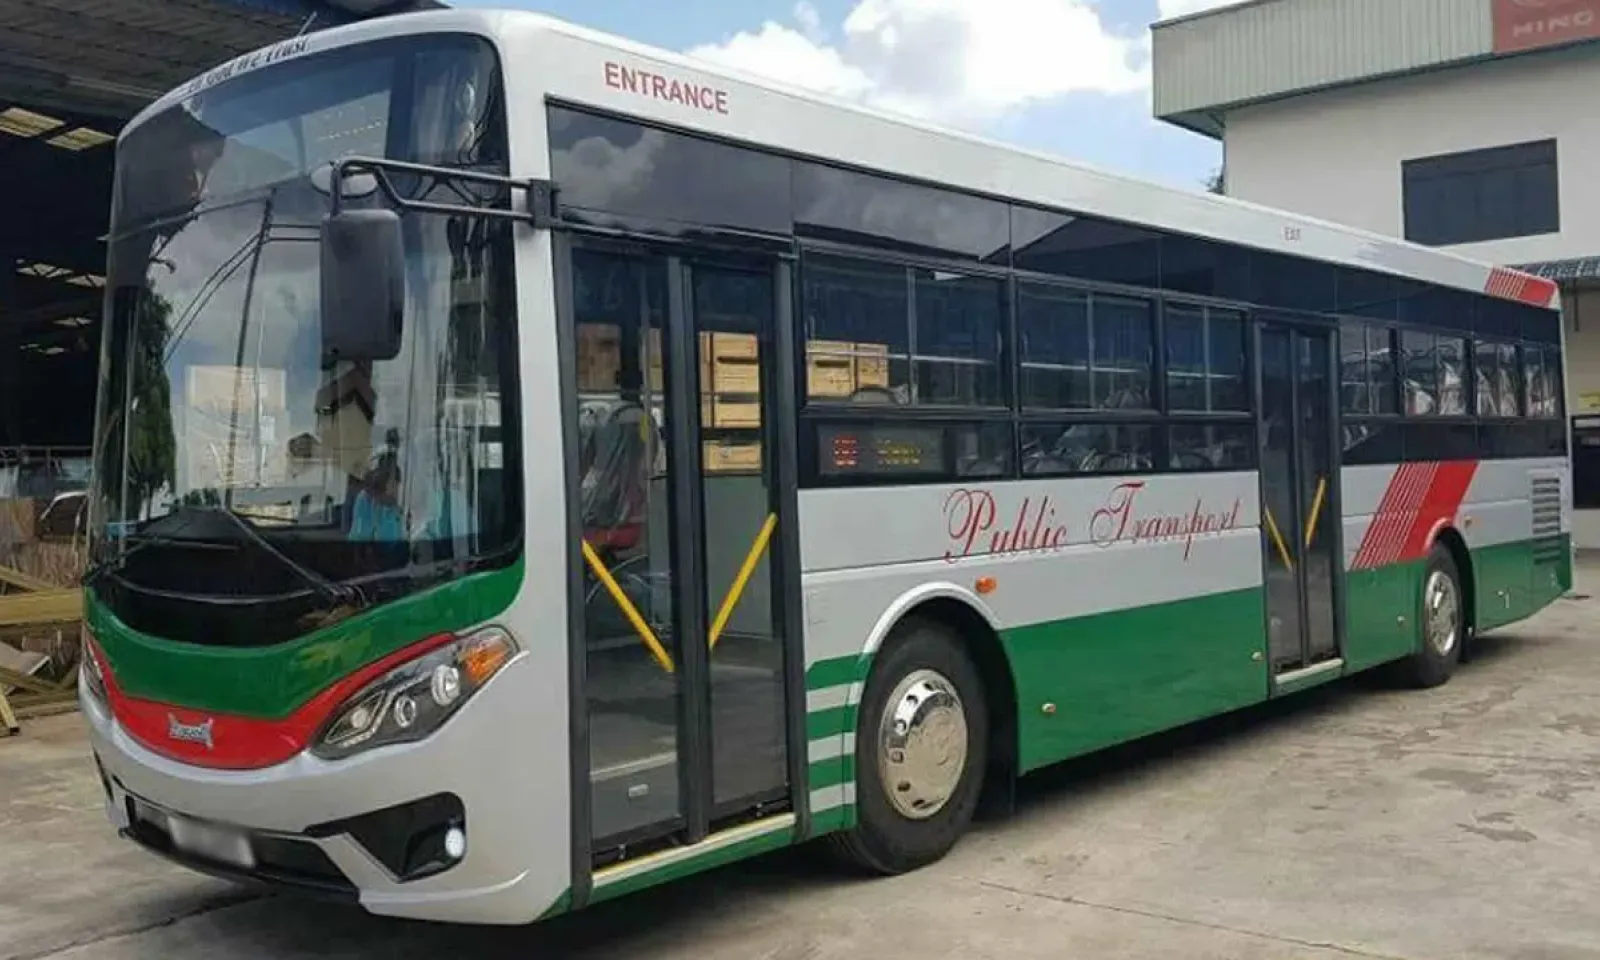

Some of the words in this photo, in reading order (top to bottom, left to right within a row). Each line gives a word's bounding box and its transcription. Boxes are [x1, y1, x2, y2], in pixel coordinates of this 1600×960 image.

[1512, 9, 1595, 38] HINO
[604, 61, 729, 115] ENTRANCE
[944, 488, 1067, 563] Public
[1090, 480, 1246, 562] Transport
